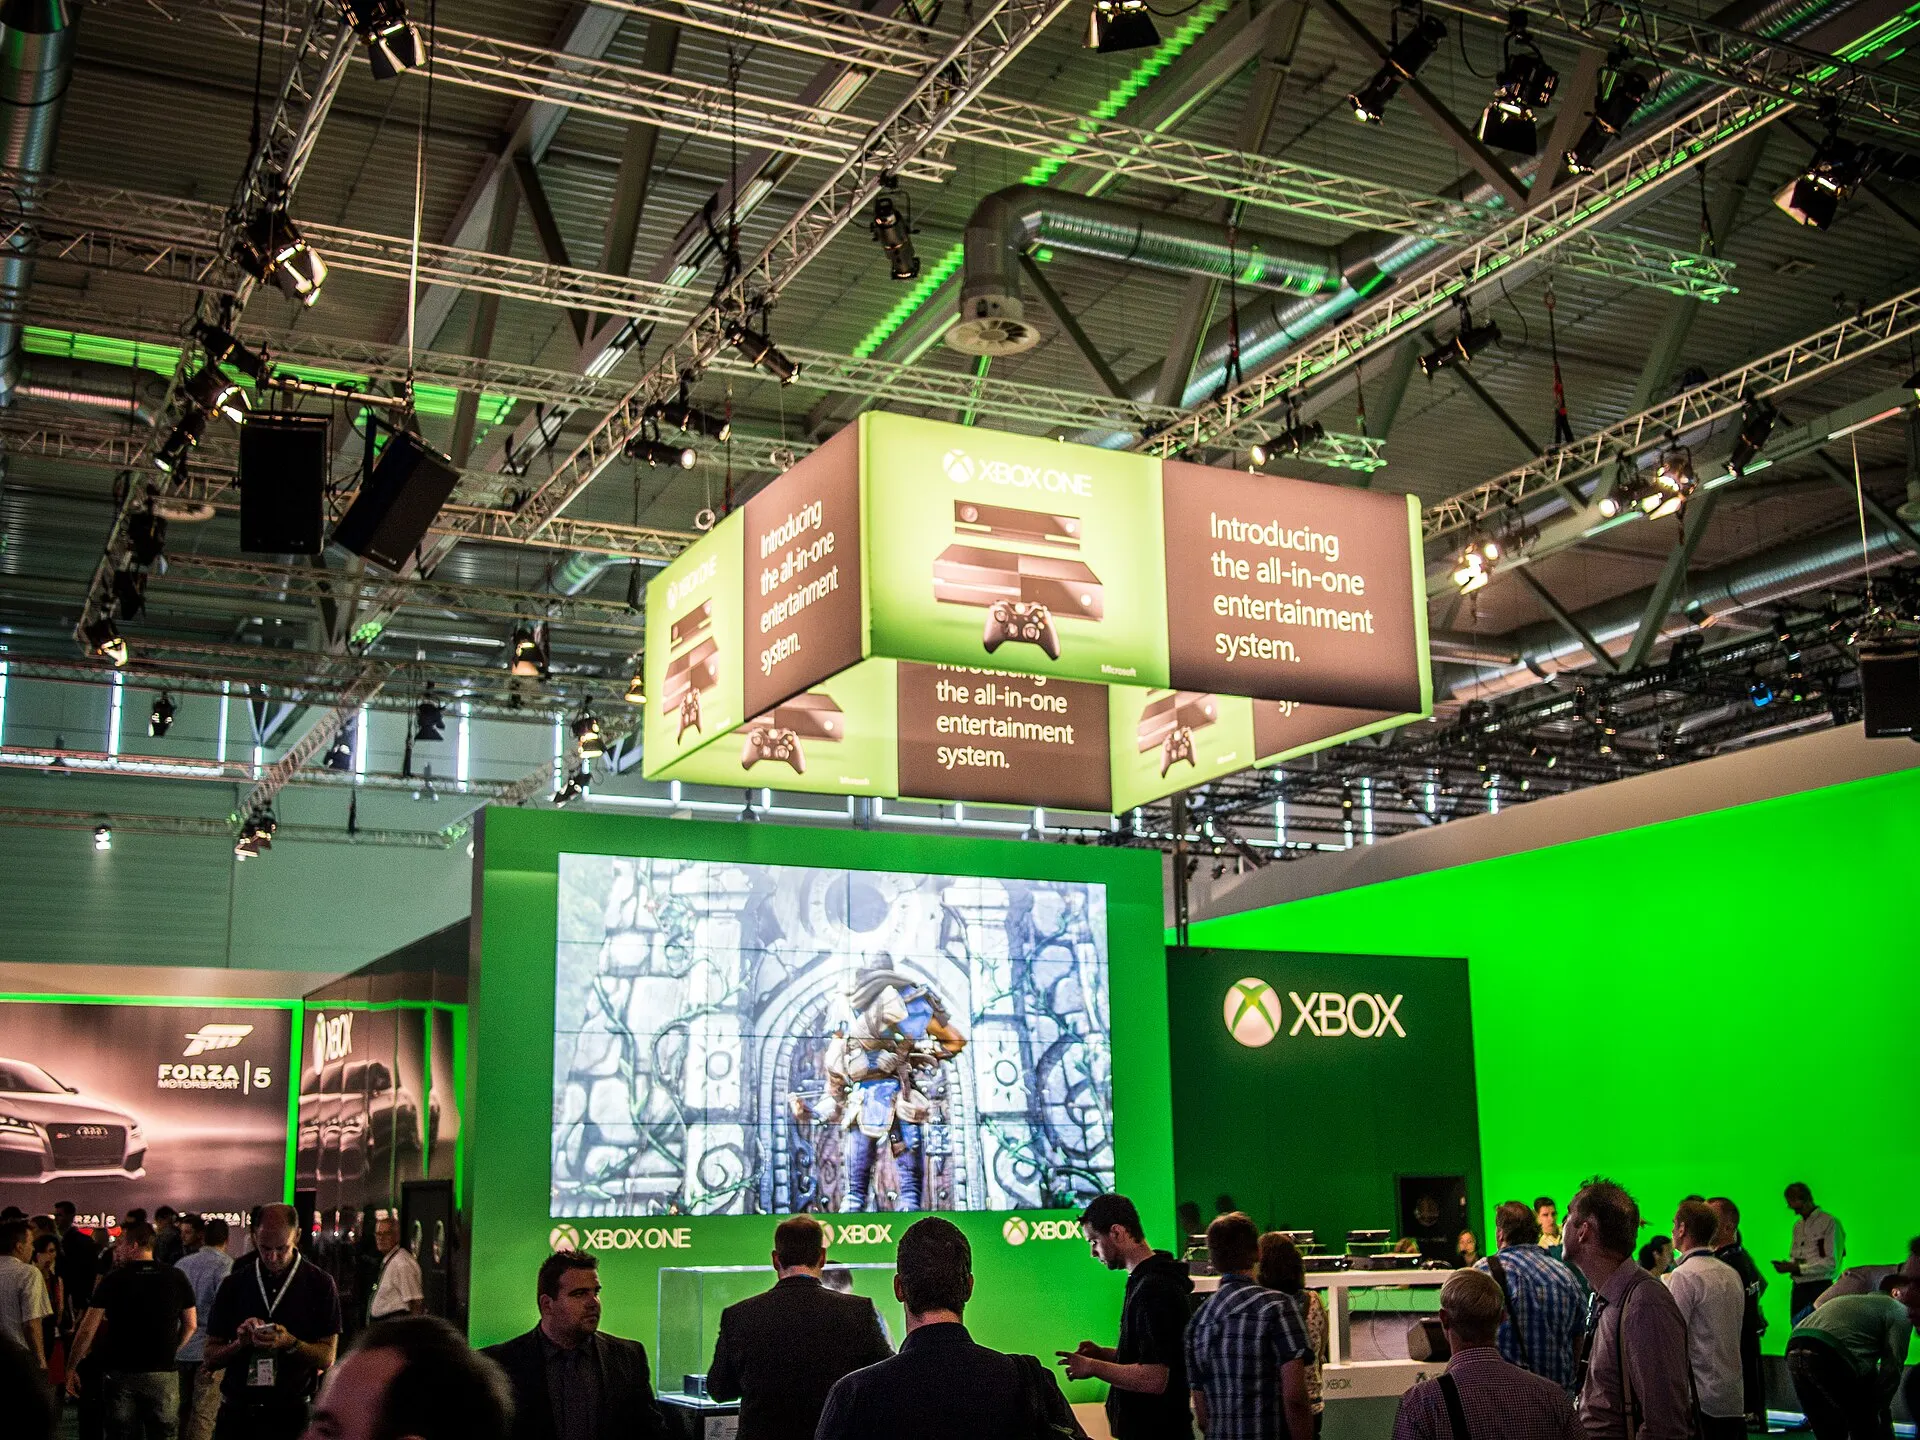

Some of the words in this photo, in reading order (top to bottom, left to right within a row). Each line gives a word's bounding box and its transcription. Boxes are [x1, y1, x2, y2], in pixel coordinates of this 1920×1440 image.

[978, 459, 1043, 490] XBOX
[1043, 469, 1093, 497] ONE
[760, 500, 823, 560] Introducing
[1210, 511, 1340, 563] Introducing
[760, 567, 780, 597] the
[779, 531, 835, 584] all-in-one
[1210, 550, 1250, 581] the
[1256, 556, 1365, 596] all-in-one
[760, 564, 839, 634] entertainment
[1213, 593, 1375, 634] entertainment
[760, 632, 801, 677] system.
[1215, 632, 1301, 663] system.
[936, 679, 970, 704] the
[974, 683, 1068, 714] all-in-one
[936, 714, 1075, 745] entertainment
[936, 745, 1010, 770] system.
[1288, 991, 1407, 1038] XBOX
[157, 1079, 240, 1090] MOTORSPORT
[158, 1063, 240, 1080] FORZA
[253, 1067, 272, 1089] 5
[582, 1228, 644, 1250] XBOX
[644, 1227, 692, 1249] ONE
[836, 1223, 893, 1245] XBOX
[1030, 1220, 1083, 1240] XBOX
